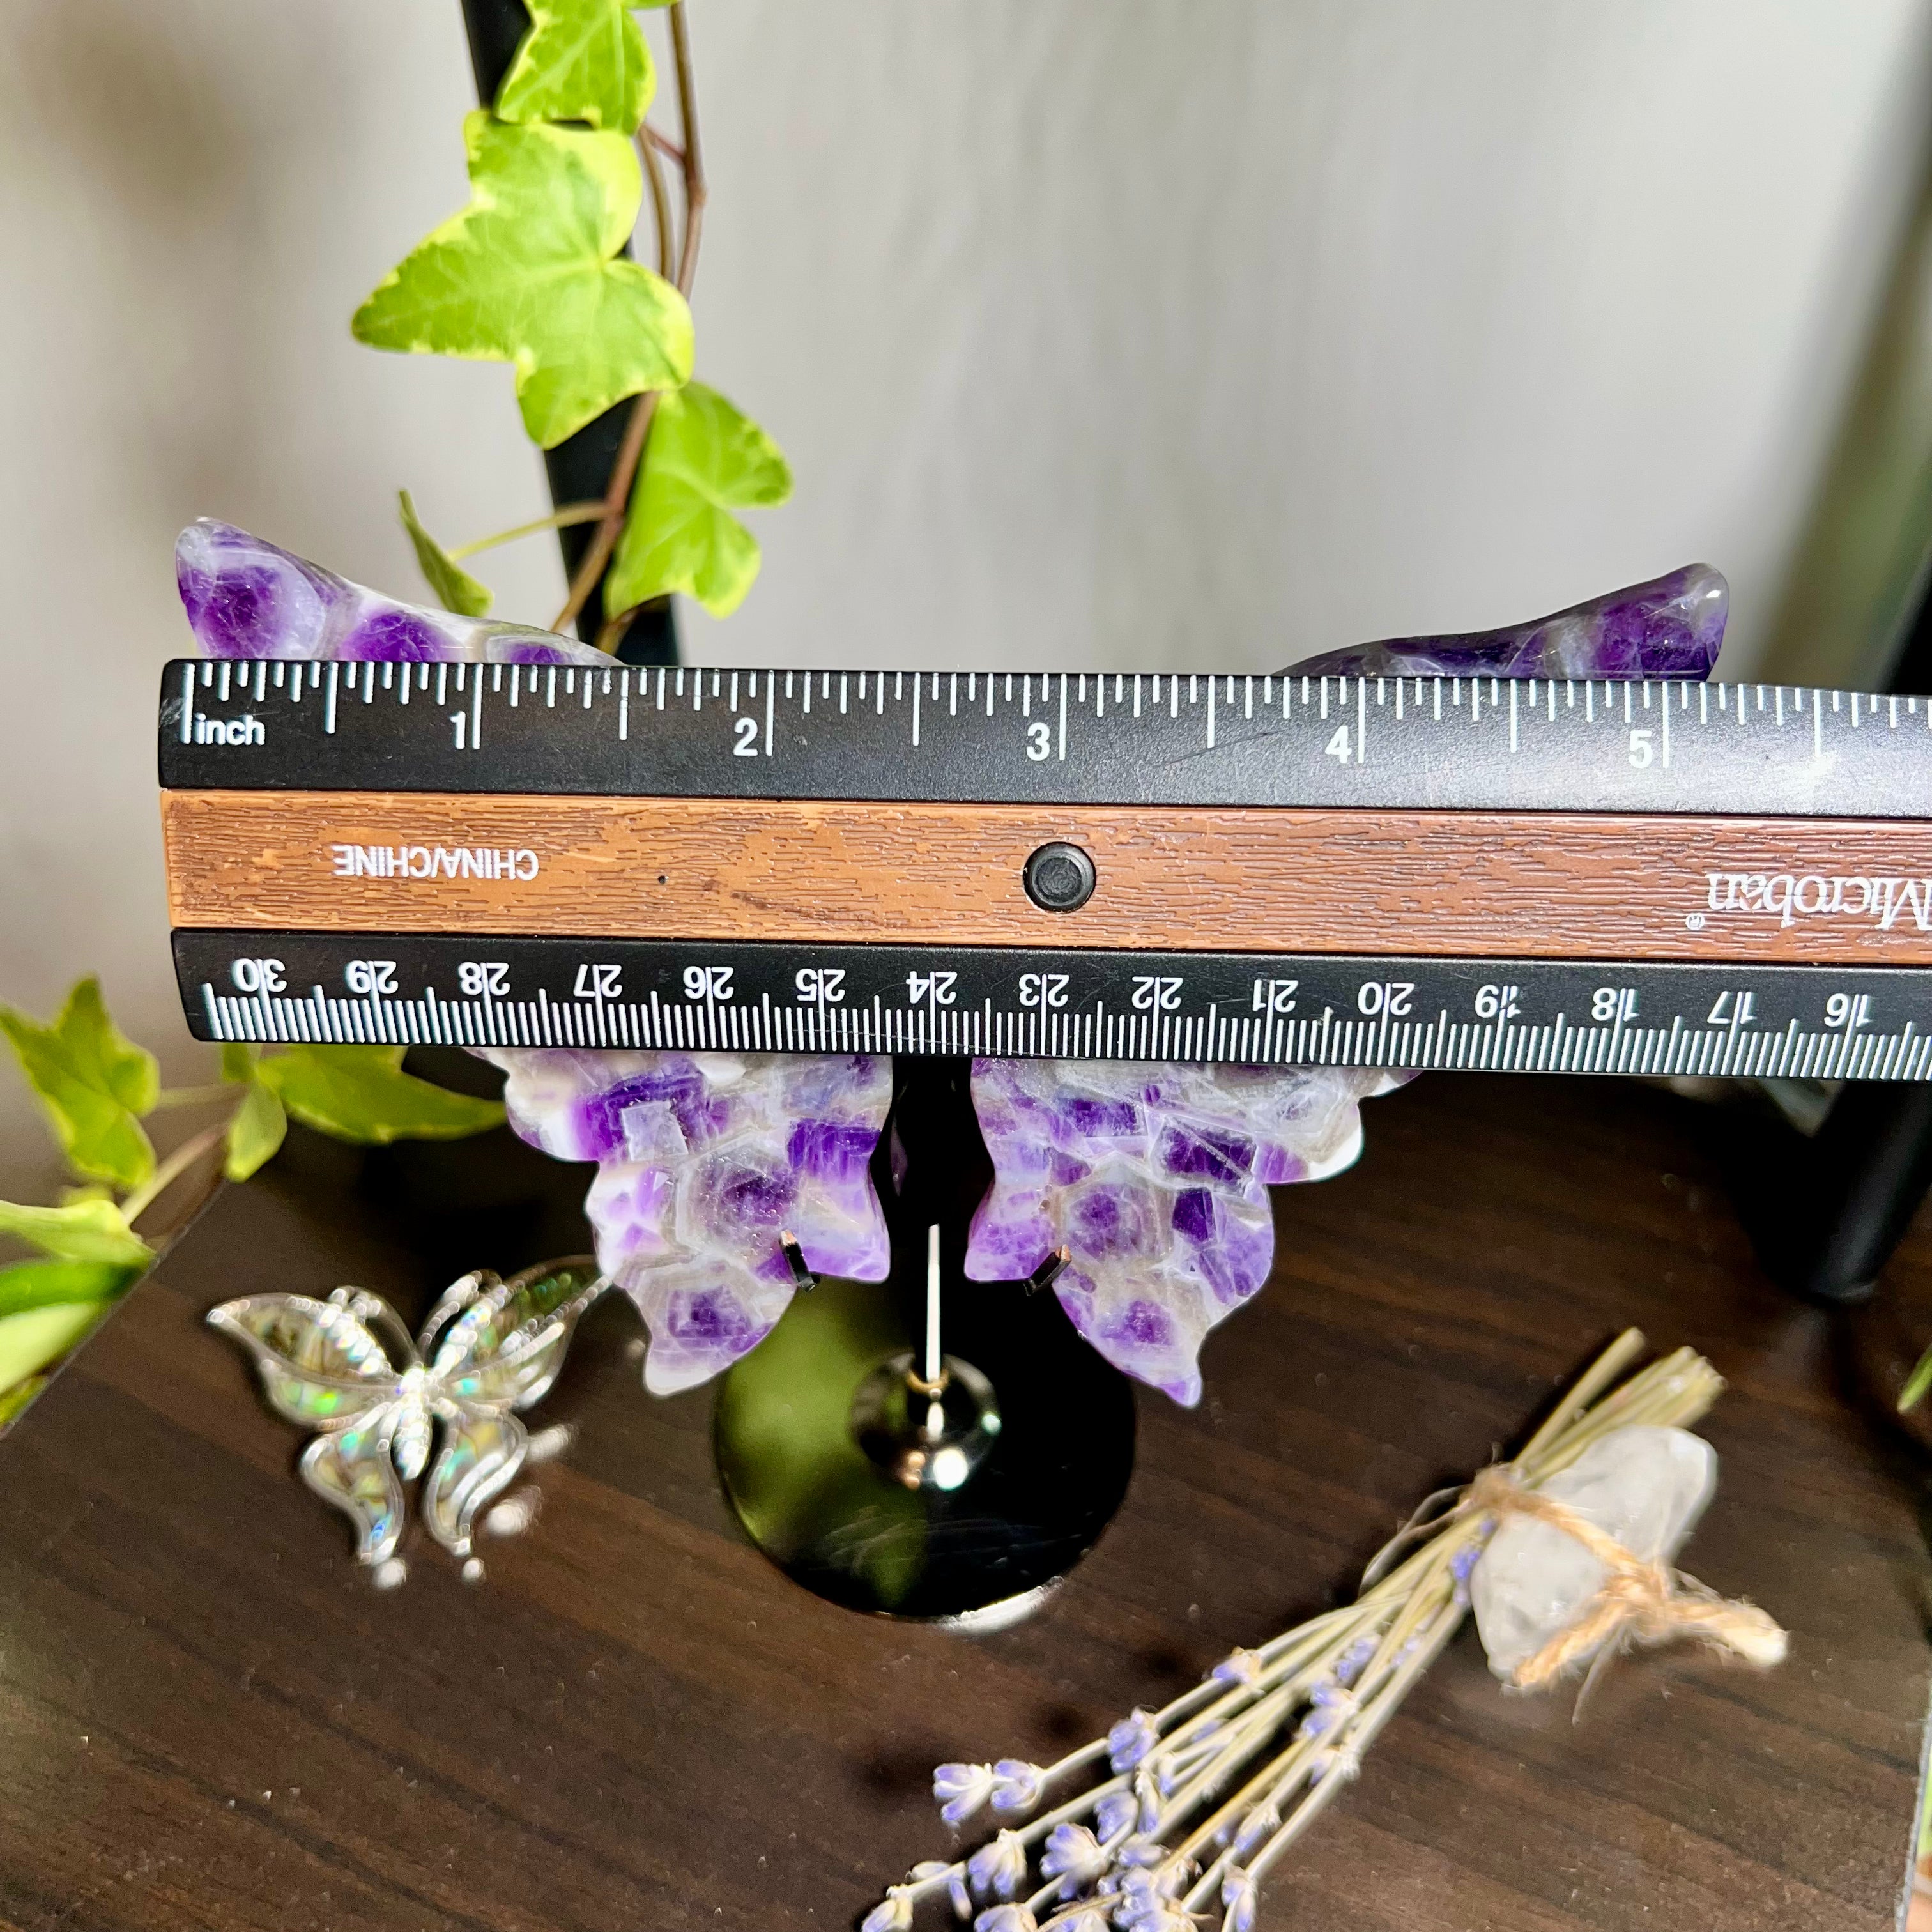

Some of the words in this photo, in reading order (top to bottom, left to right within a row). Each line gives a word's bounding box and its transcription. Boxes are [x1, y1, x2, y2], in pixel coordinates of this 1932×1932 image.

[195, 715, 264, 745] inch
[450, 712, 465, 749] 1
[733, 717, 758, 757] 2
[1026, 722, 1050, 762] 3
[1324, 724, 1351, 764] 4
[1628, 730, 1653, 769] 5
[332, 845, 540, 881] CHINA/CHINE
[232, 959, 287, 993] 30
[348, 960, 398, 994] 29
[459, 962, 510, 996] 28
[574, 963, 622, 998] 27
[684, 966, 733, 1001] 26
[795, 969, 845, 1002] 25
[906, 971, 957, 1004] 24
[1018, 973, 1069, 1007] 23
[1131, 976, 1183, 1010] 22
[1252, 980, 1298, 1013] 21
[1358, 981, 1414, 1016] 20
[1475, 985, 1520, 1018] 19
[1591, 987, 1641, 1021] 18
[1707, 990, 1757, 1025] 17
[1823, 993, 1872, 1026] 16
